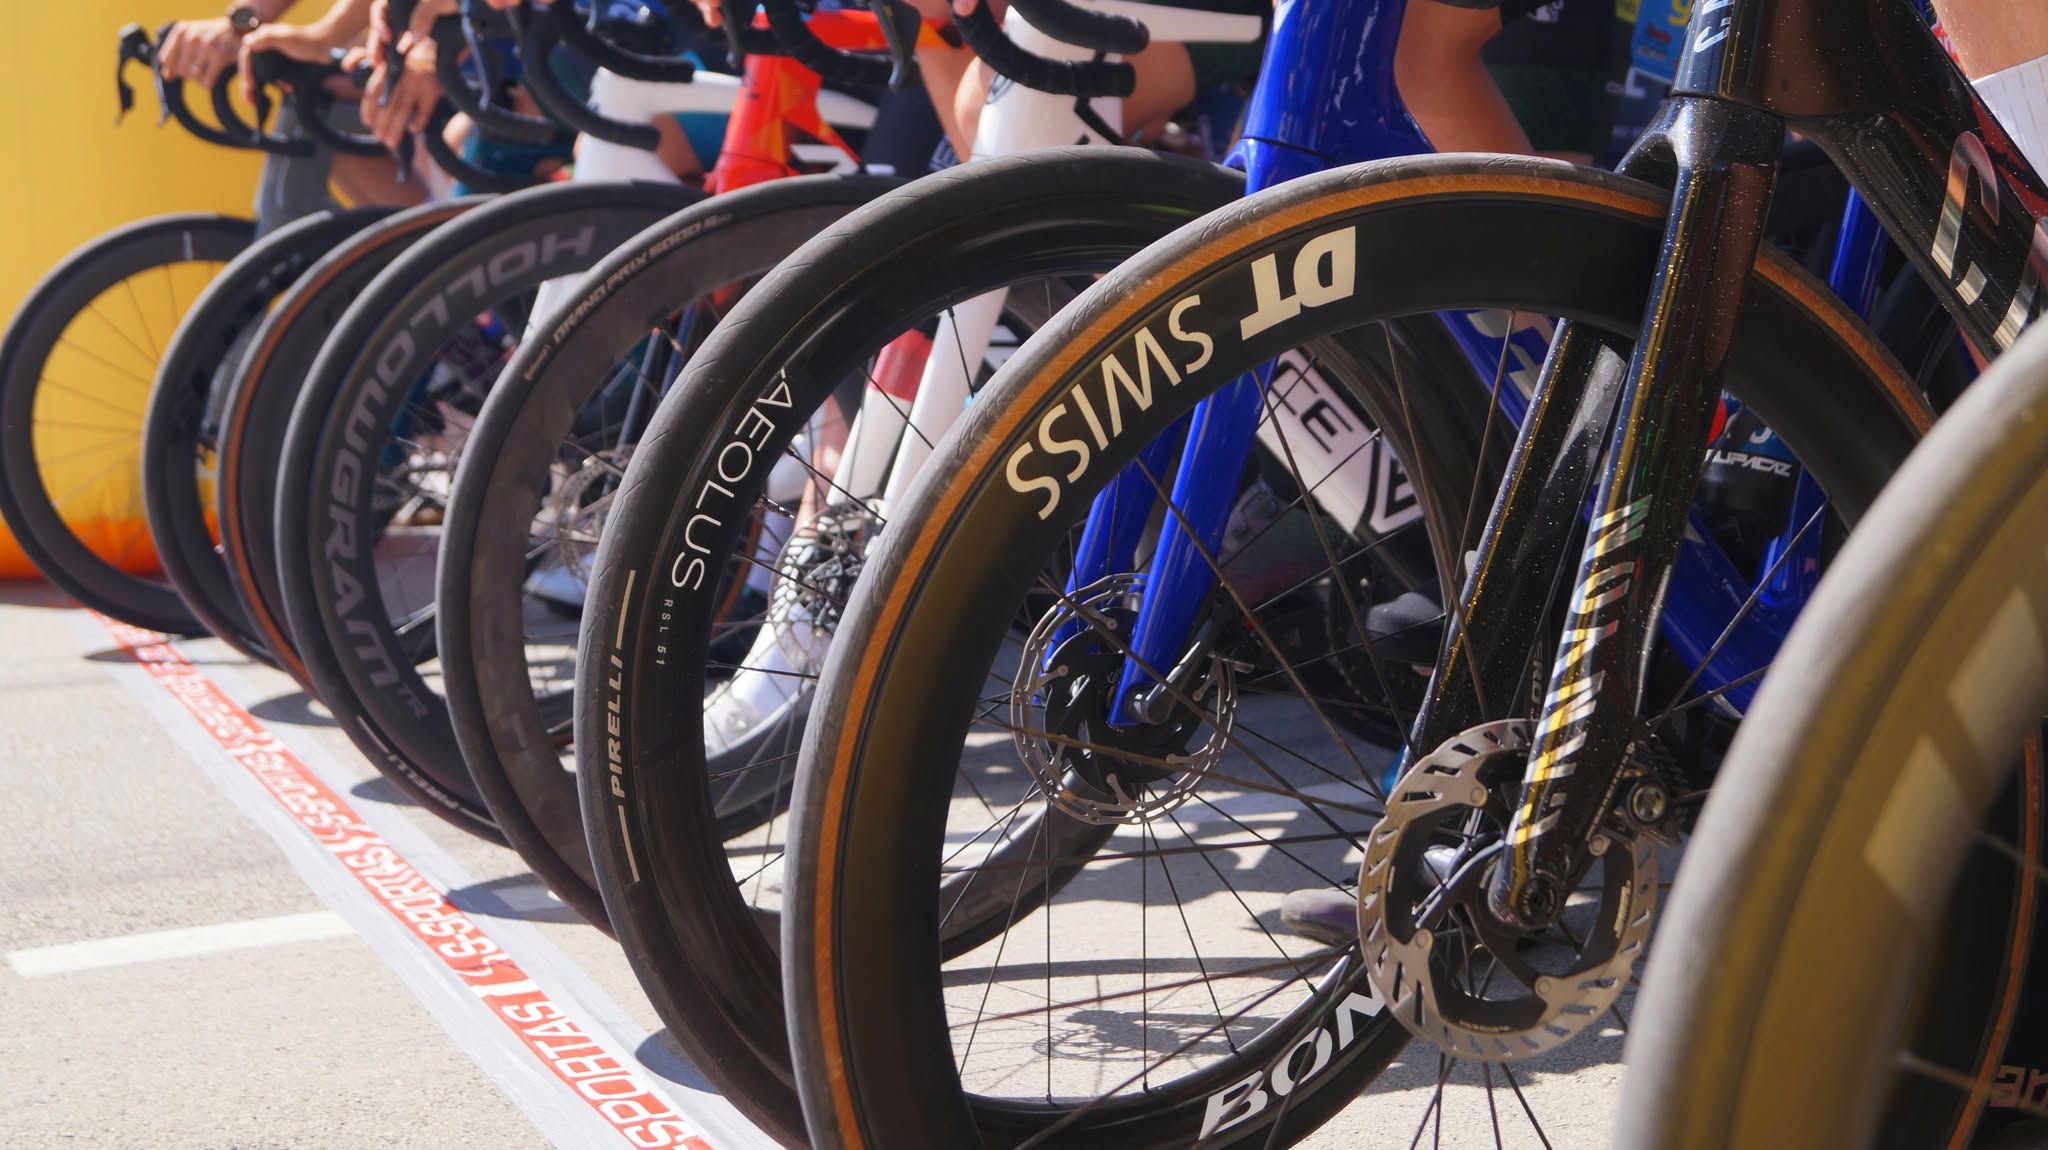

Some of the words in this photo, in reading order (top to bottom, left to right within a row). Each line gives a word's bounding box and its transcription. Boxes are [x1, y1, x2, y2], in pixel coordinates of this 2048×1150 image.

[553, 284, 607, 343] GRAND
[606, 250, 649, 291] PRIX
[1240, 225, 1357, 342] DT
[1005, 294, 1214, 521] SWISS
[671, 367, 793, 591] AEOLUS
[655, 645, 667, 666] 51
[658, 598, 674, 633] RSL
[1504, 493, 1654, 847] CANYON
[607, 654, 626, 799] PIRELLI
